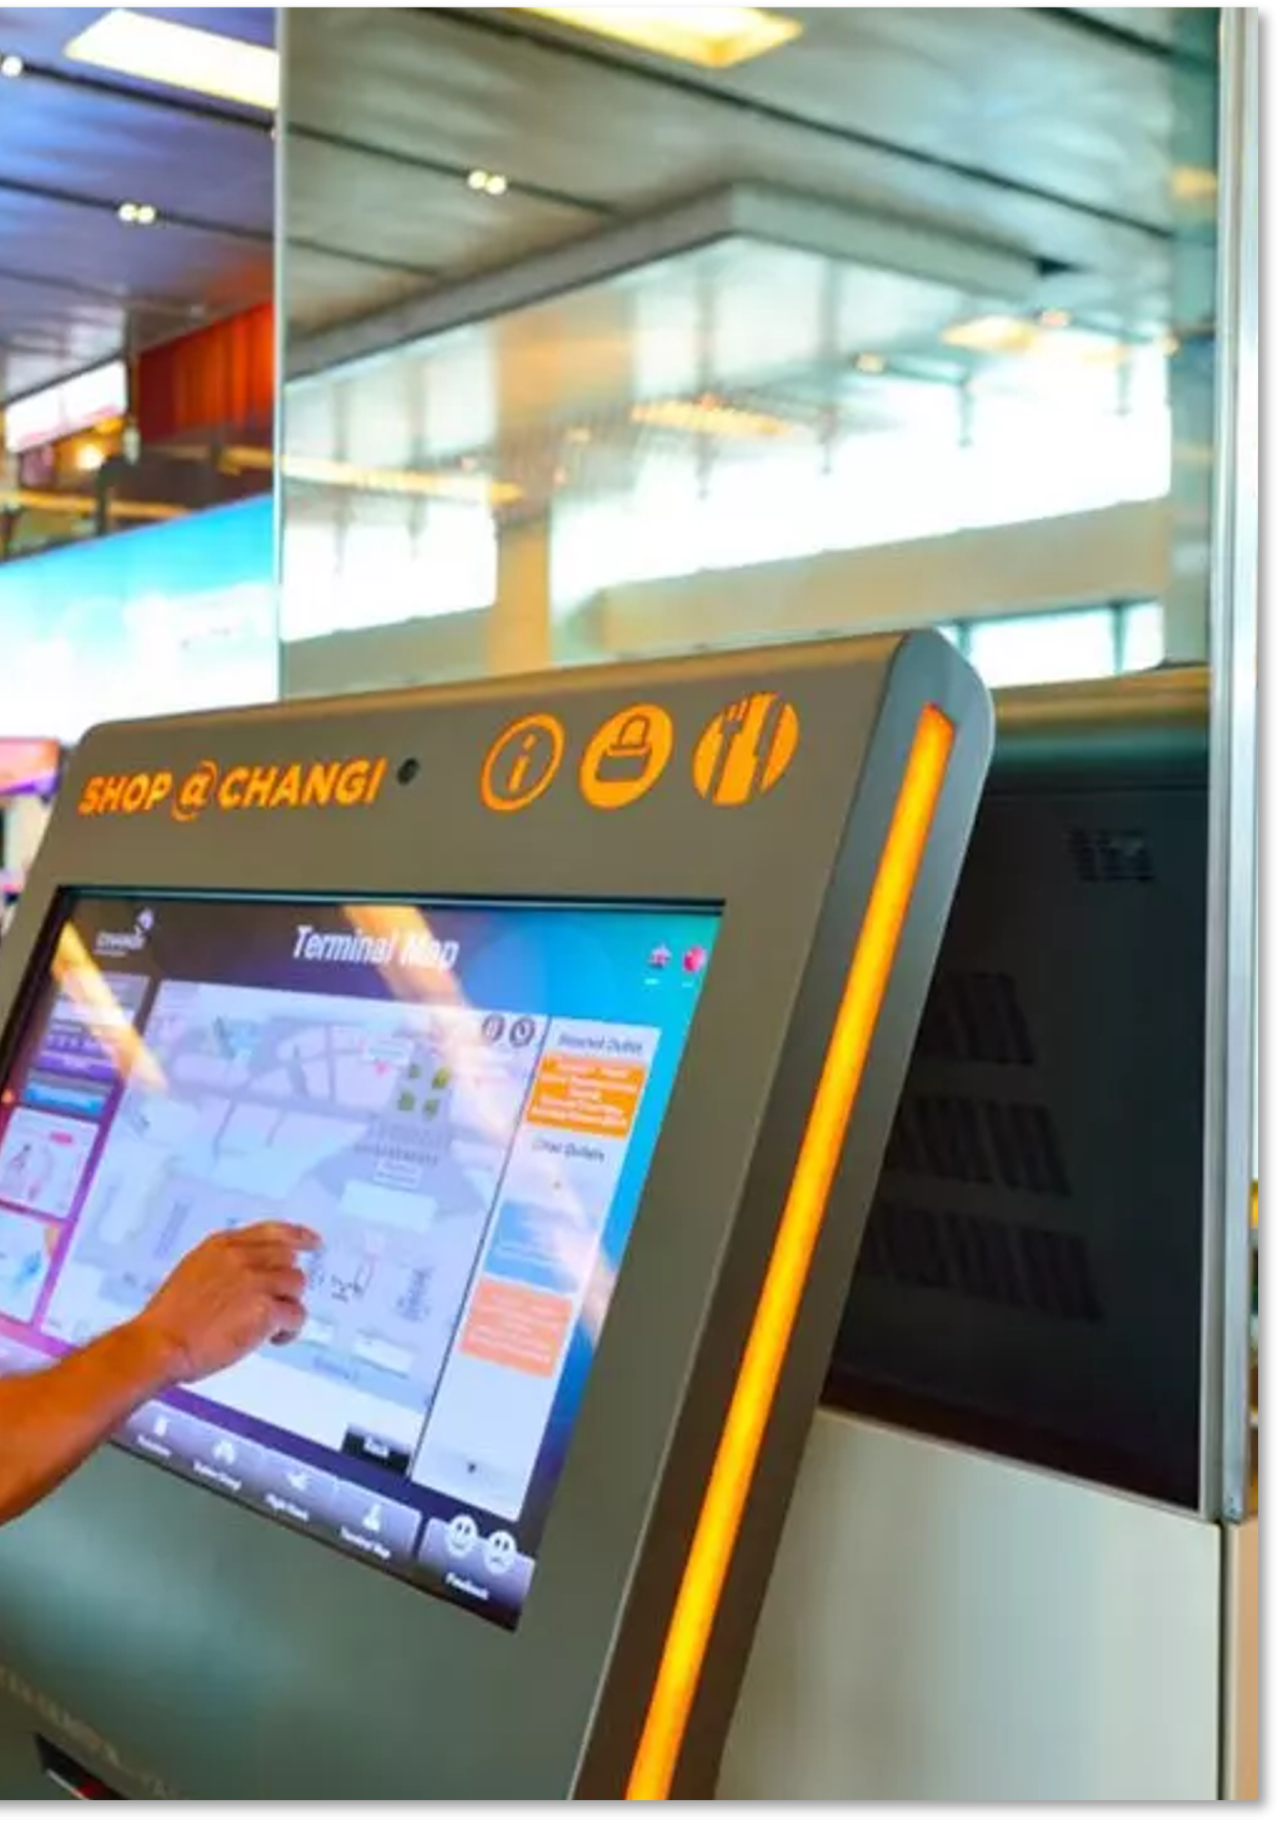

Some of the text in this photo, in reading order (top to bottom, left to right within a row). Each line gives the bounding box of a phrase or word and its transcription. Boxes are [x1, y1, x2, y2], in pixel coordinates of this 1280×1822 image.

[78, 771, 173, 816] SHOP
[219, 756, 387, 808] CHANGI
[293, 924, 460, 971] Terminal Map
